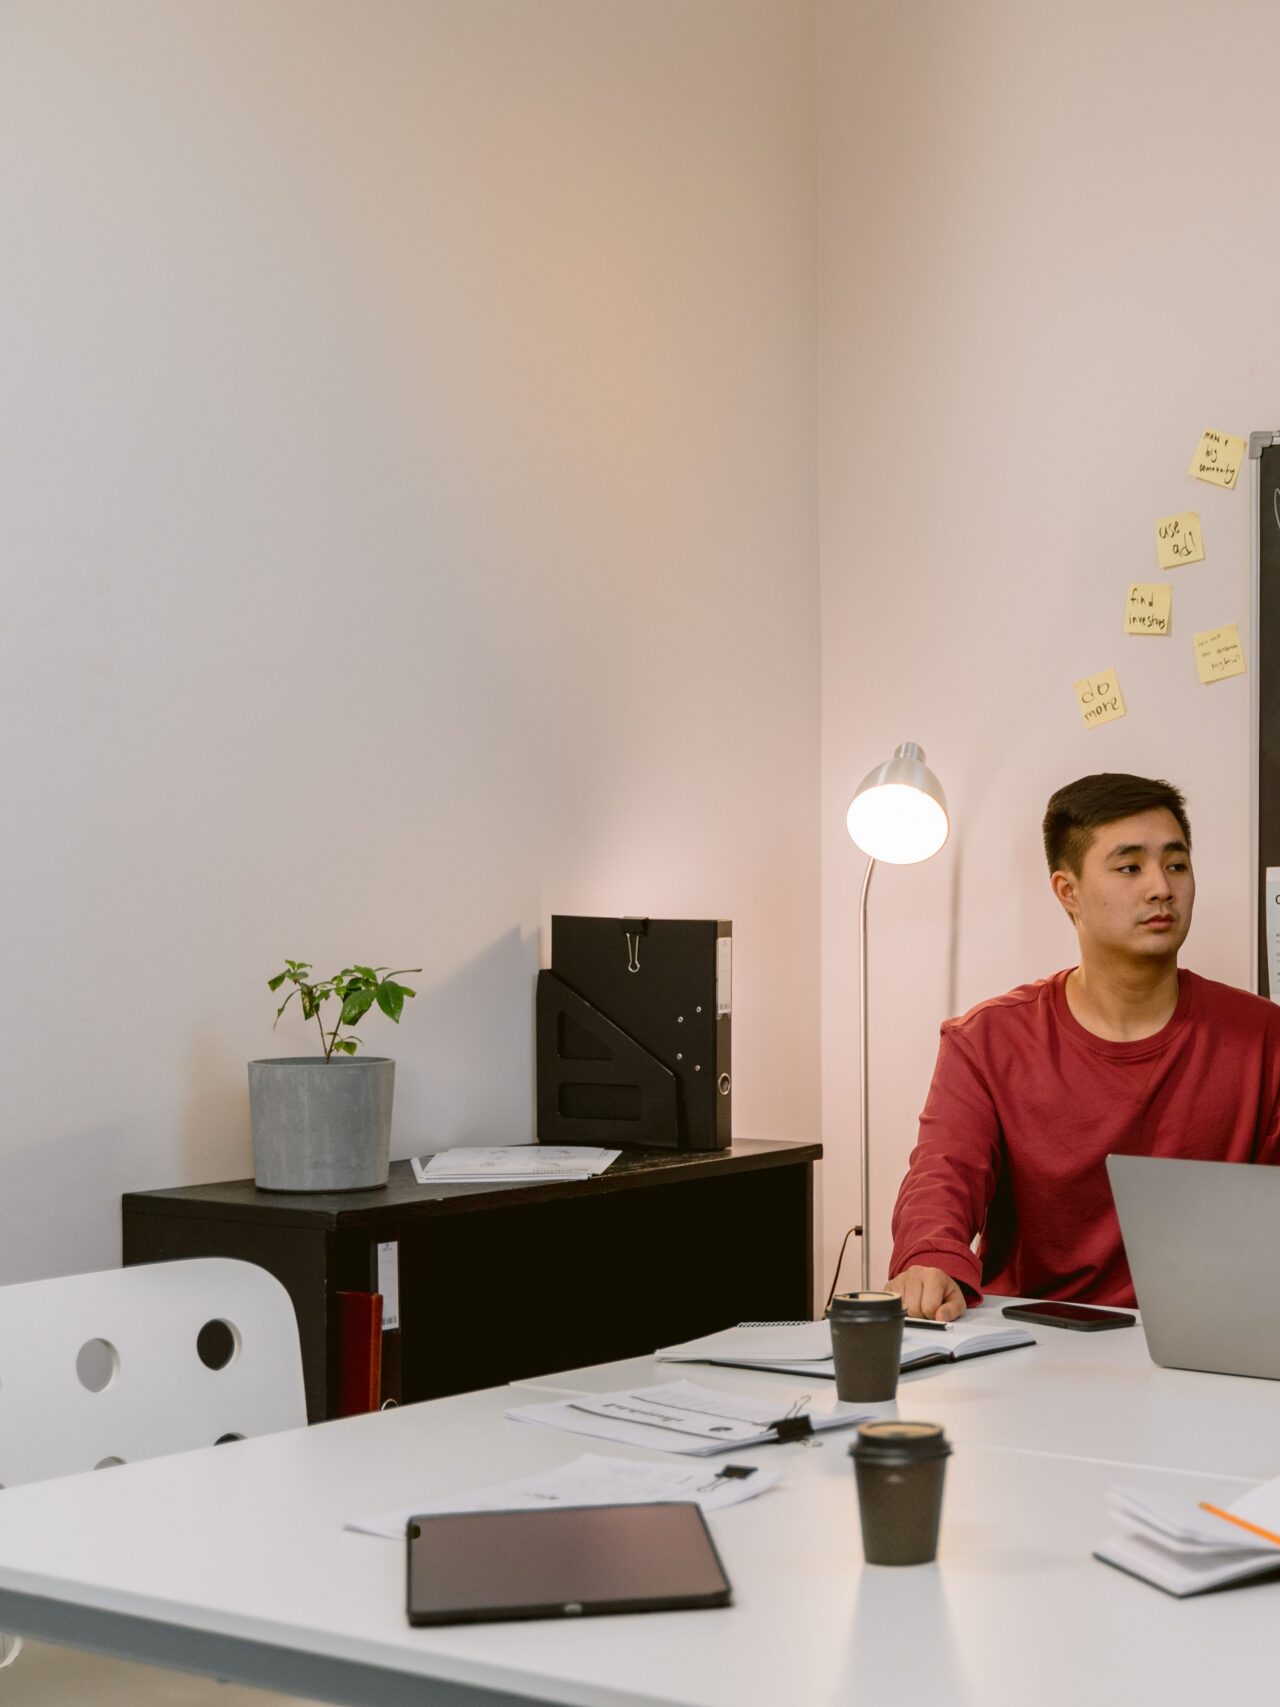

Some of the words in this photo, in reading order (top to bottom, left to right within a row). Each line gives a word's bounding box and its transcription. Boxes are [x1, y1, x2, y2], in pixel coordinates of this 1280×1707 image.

[1158, 520, 1181, 539] use
[1130, 587, 1154, 607] find
[1081, 679, 1111, 704] do
[1084, 696, 1121, 722] more
